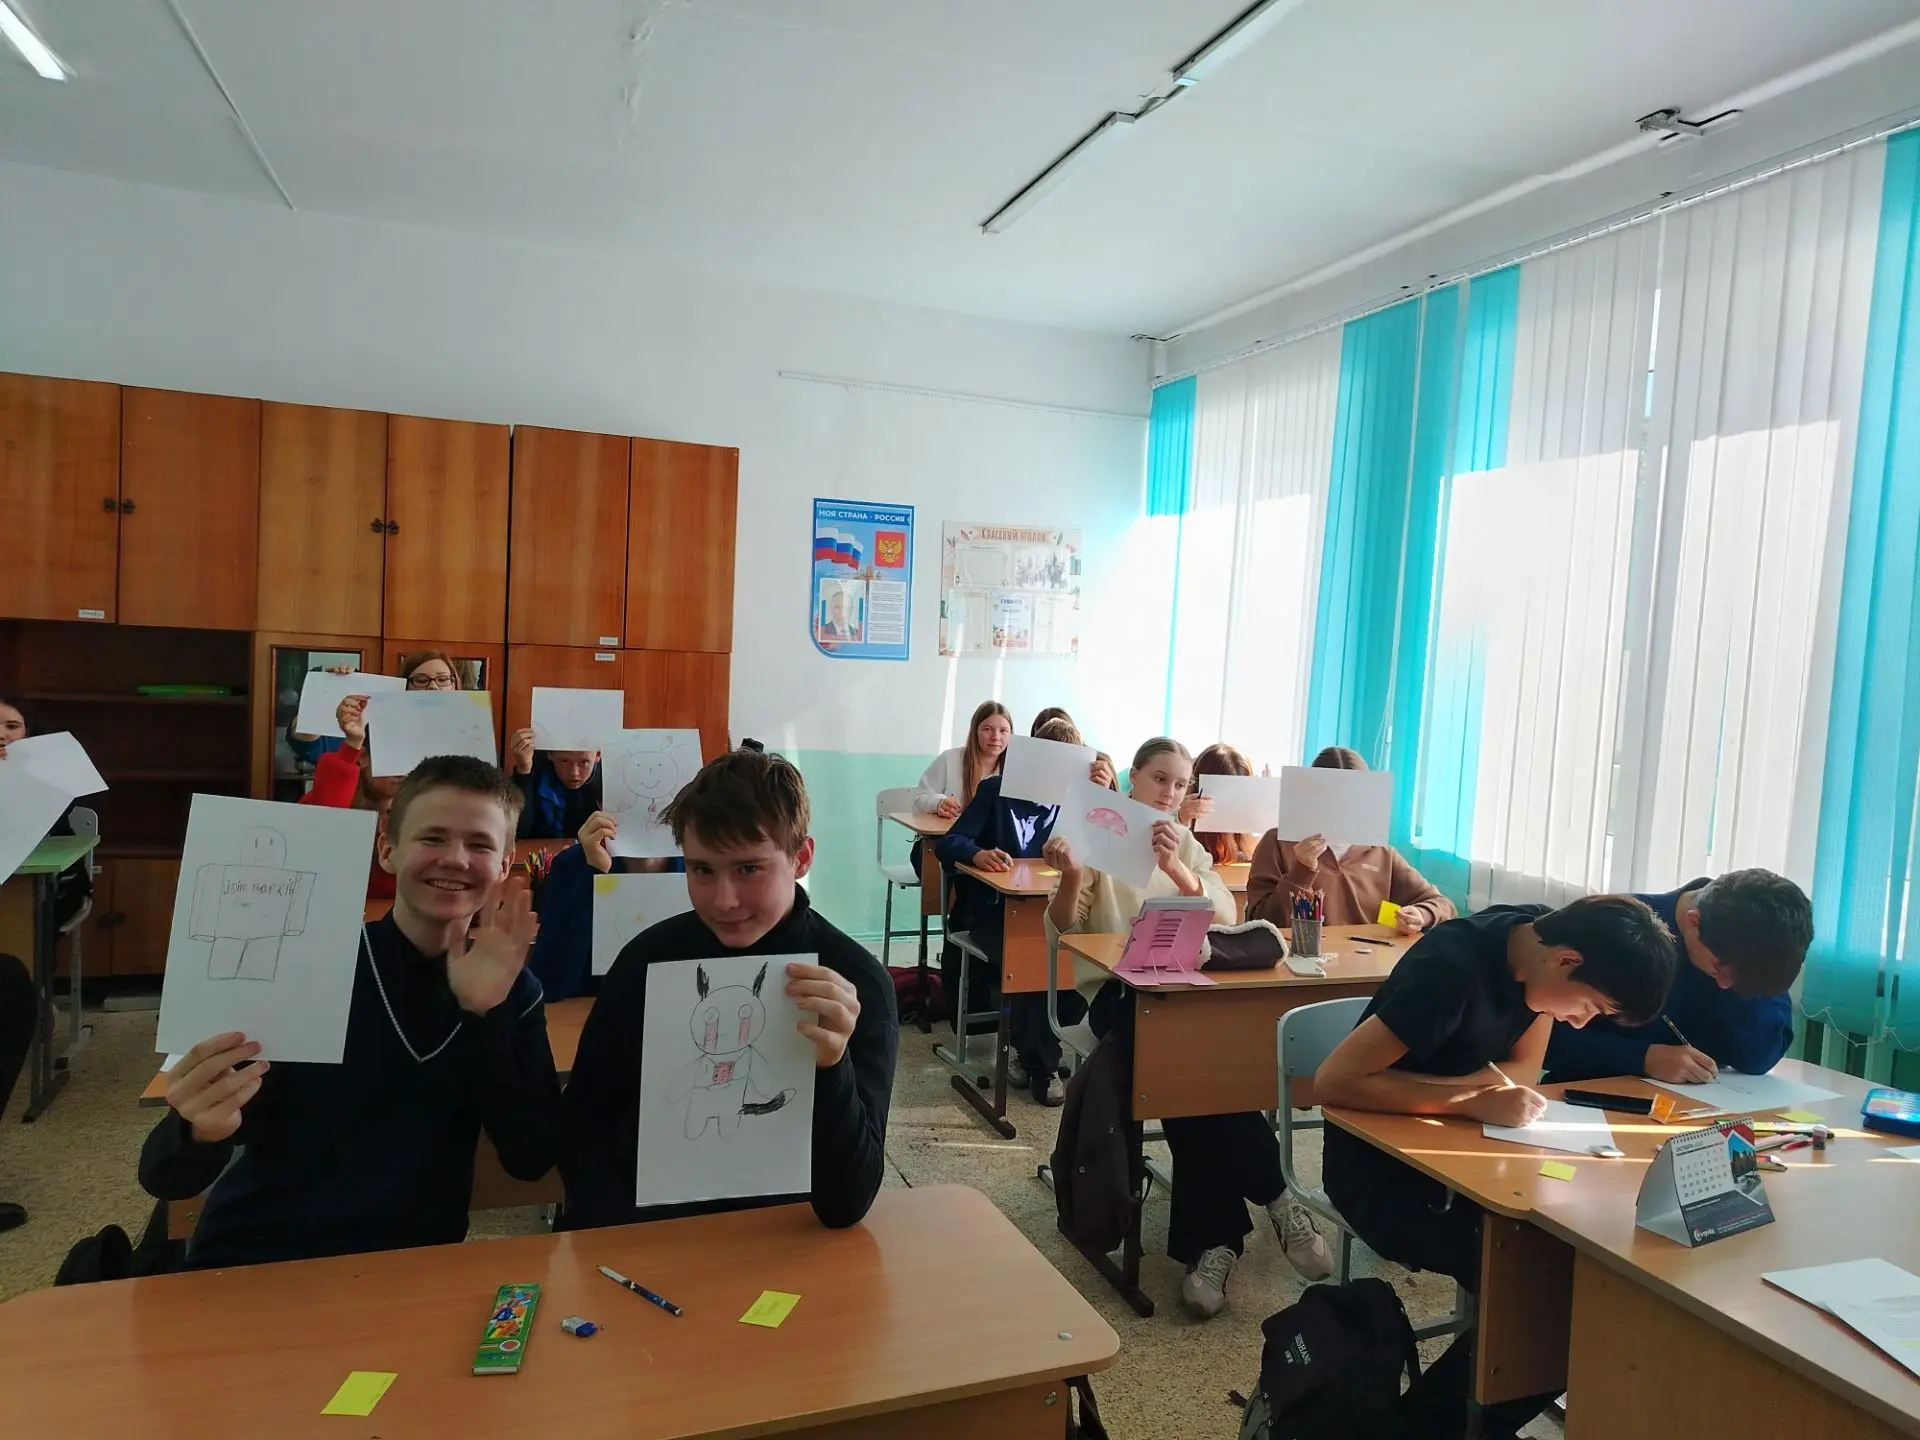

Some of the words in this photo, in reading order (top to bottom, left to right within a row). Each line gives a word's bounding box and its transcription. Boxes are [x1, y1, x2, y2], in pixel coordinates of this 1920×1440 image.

[818, 509, 837, 518] МОЯ
[838, 511, 868, 521] СТРАНА
[874, 513, 906, 523] РОССИЯ
[981, 527, 1018, 541] КЛАССНЫЙ
